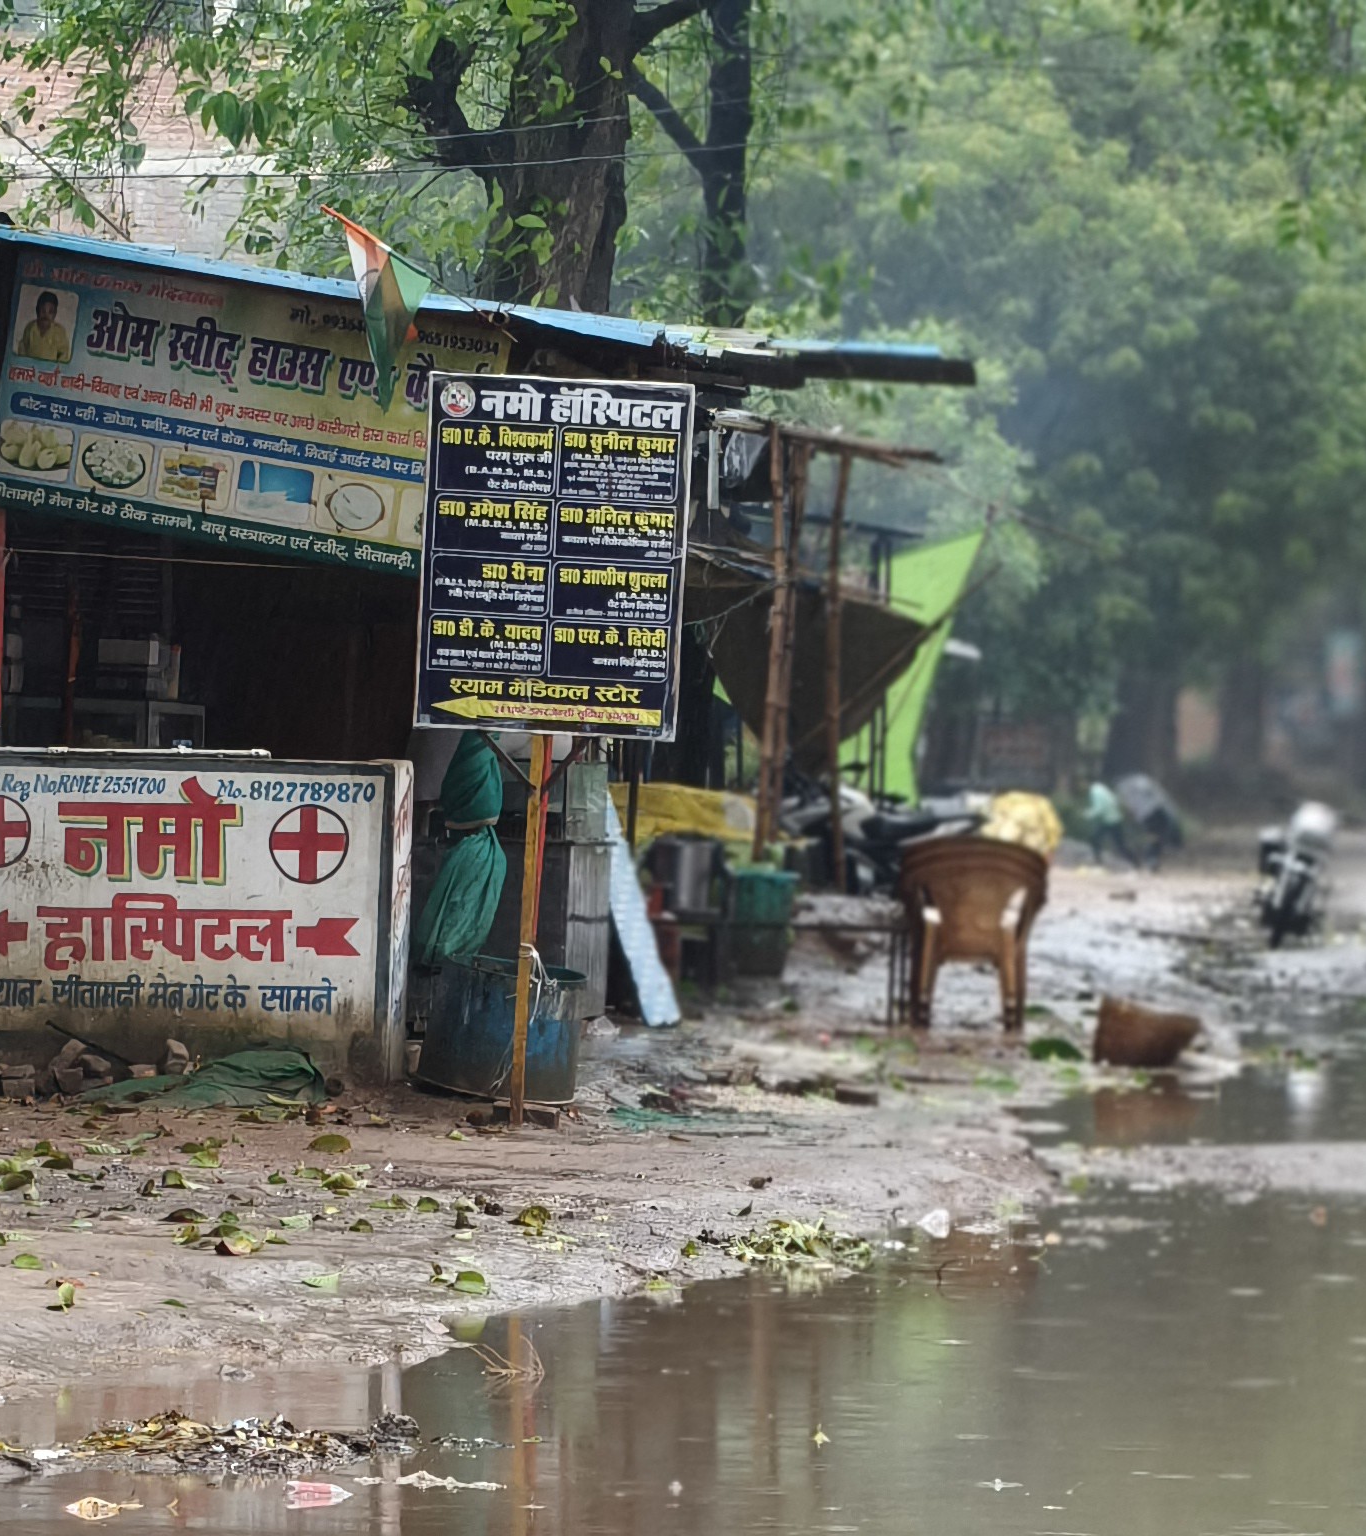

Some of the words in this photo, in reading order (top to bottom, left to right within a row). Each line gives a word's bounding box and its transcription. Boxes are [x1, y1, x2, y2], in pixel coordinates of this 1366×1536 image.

[87, 301, 161, 360] ओम
[248, 337, 332, 390] हाउस
[170, 390, 197, 411] किसी
[200, 395, 212, 412] भी
[216, 403, 235, 422] शुभ
[237, 406, 271, 423] अवसर
[274, 412, 287, 425] पर
[480, 383, 546, 421] नमो
[550, 387, 686, 430] हॉस्पिटल
[499, 426, 554, 449] विश्वकर्मा
[590, 431, 634, 454] सुनील
[636, 436, 676, 457] कुमार
[393, 464, 409, 474] पर
[76, 497, 98, 513] गेट
[102, 502, 117, 515] के
[120, 503, 148, 521] ठीक
[470, 499, 511, 519] उमेश
[514, 500, 548, 520] सिंह
[586, 506, 632, 525] अनिल
[635, 511, 675, 532] कुमार
[512, 562, 546, 581] रीना
[583, 567, 627, 585] आशीष
[629, 572, 668, 592] शुक्ला
[505, 625, 543, 640] यादव
[627, 628, 666, 647] द्विवेदी
[450, 678, 504, 695] श्याम
[508, 678, 590, 700] मेडिकल
[594, 684, 643, 704] स्टोर
[250, 780, 377, 803] 8127789870
[58, 776, 240, 884] नमो
[37, 893, 292, 970] हास्पिटल
[148, 972, 186, 1011] मेन
[186, 975, 219, 1011] गेट
[222, 973, 250, 1008] के
[258, 977, 337, 1015] सामने
